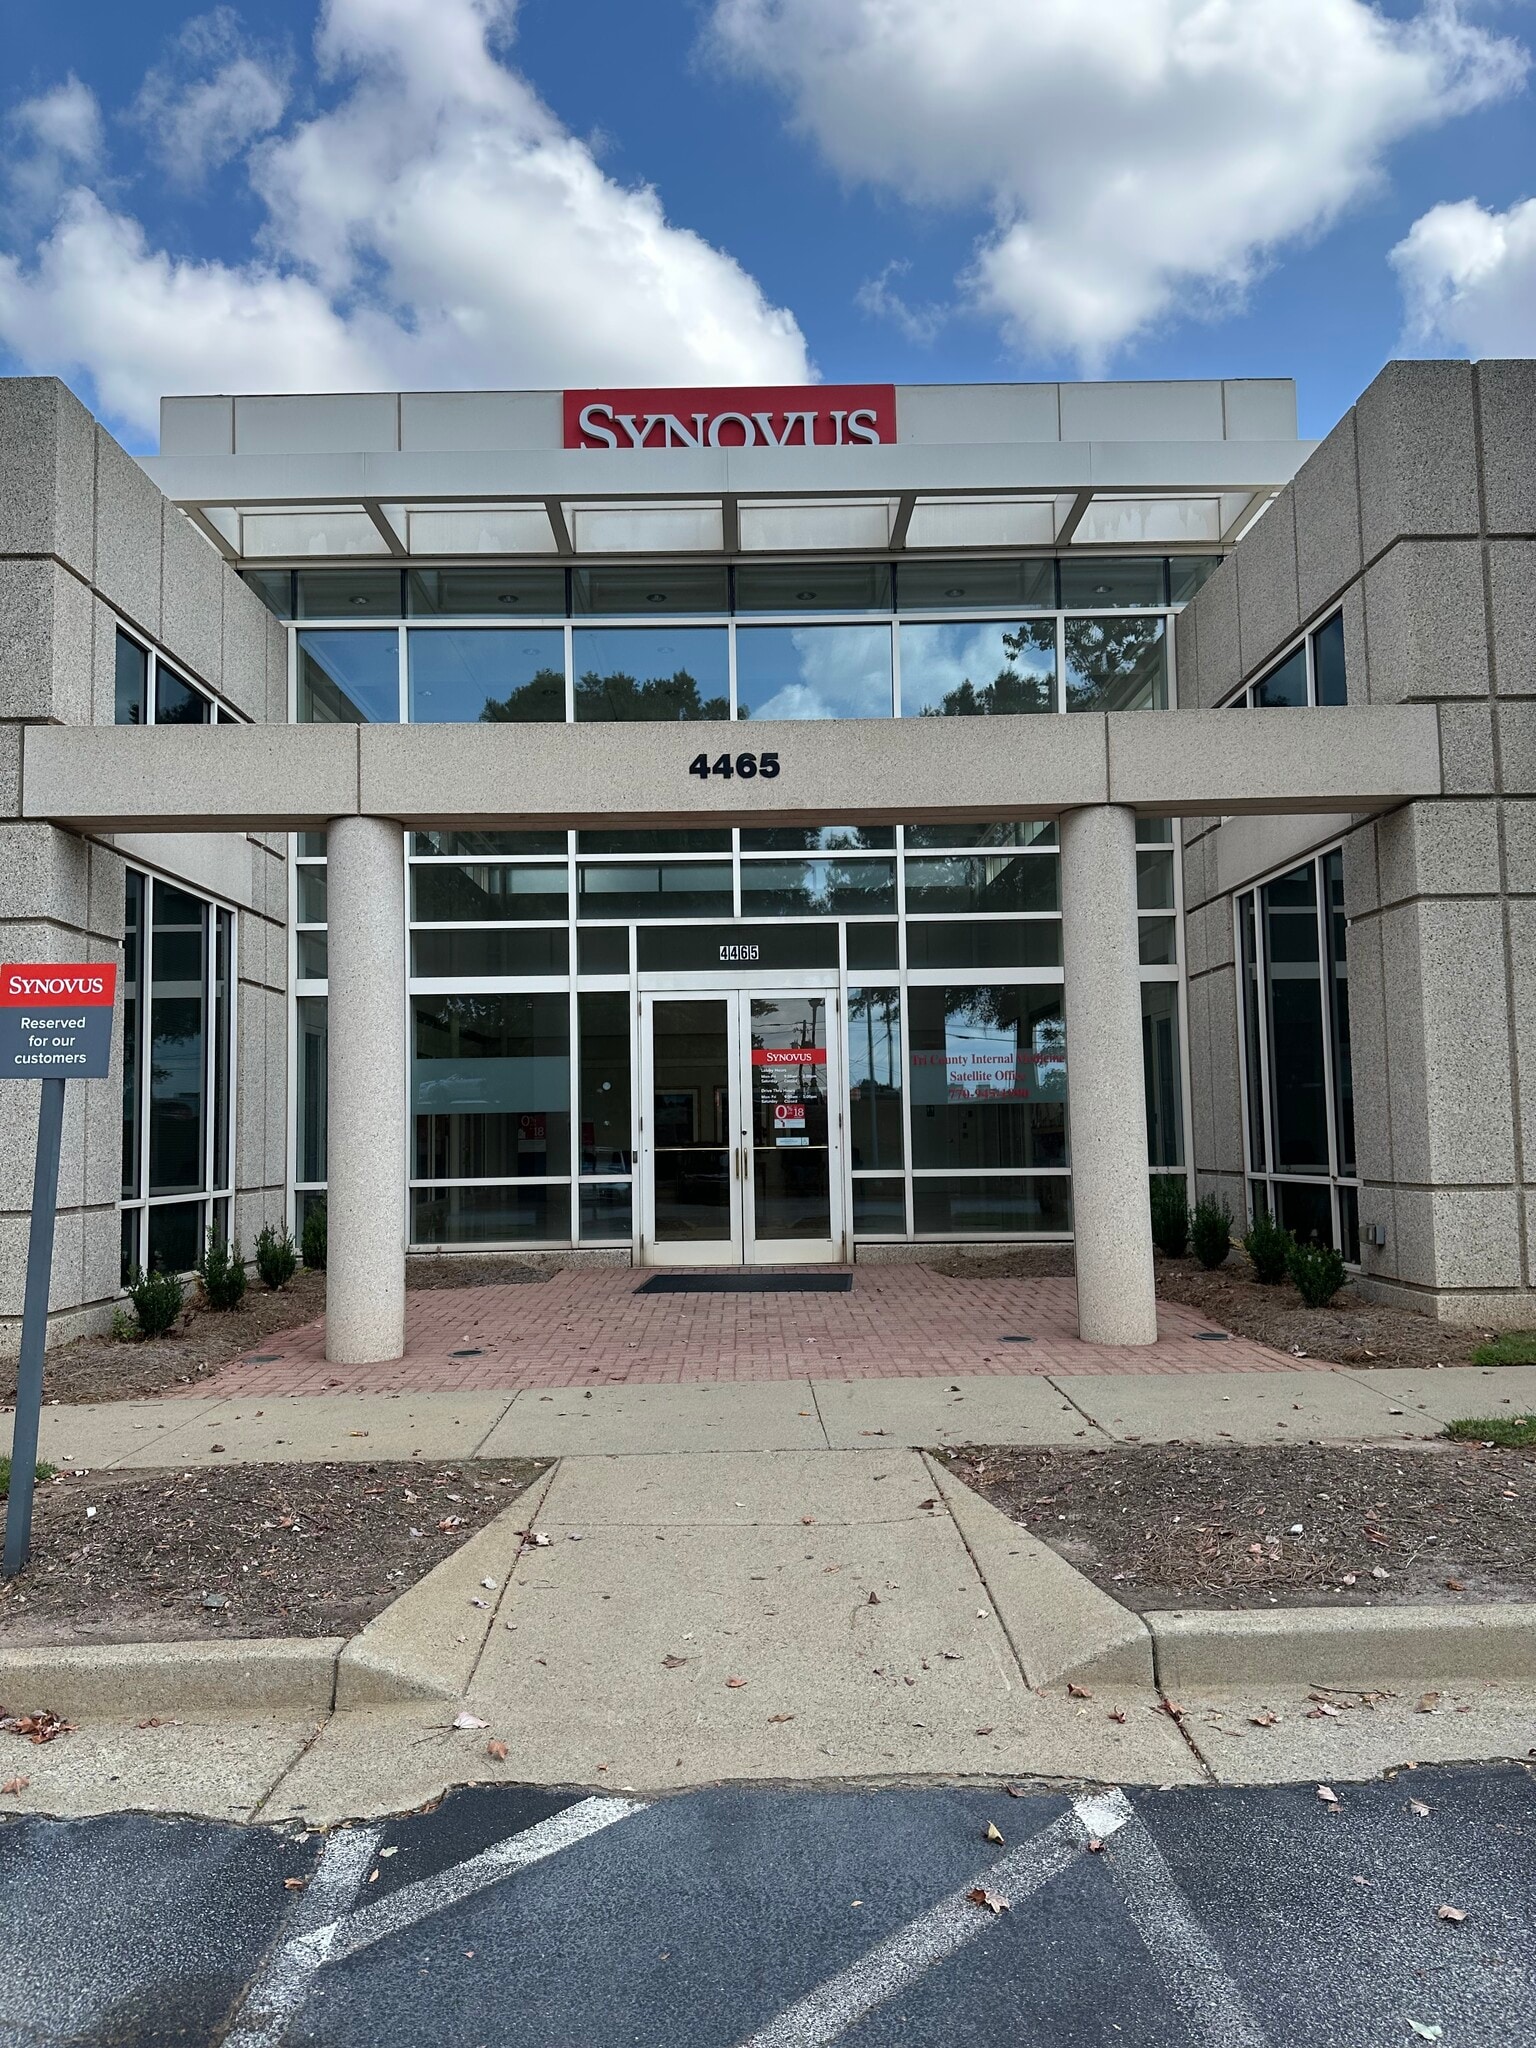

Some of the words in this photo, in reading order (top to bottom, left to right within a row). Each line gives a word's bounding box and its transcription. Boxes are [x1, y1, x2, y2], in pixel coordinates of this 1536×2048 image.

[579, 404, 880, 449] SYNOVUS
[689, 752, 781, 779] 4465
[720, 945, 759, 960] 4465
[9, 976, 103, 994] SYNOVUS
[21, 1017, 86, 1029] Reserved
[29, 1035, 48, 1047] for
[52, 1037, 76, 1047] our
[14, 1053, 87, 1064] customers
[766, 1052, 812, 1062] SYNOVUS
[912, 1055, 927, 1066] Tri
[930, 1054, 968, 1066] County
[972, 1053, 1014, 1065] Internal
[950, 1070, 992, 1081] Satellite
[794, 1108, 804, 1117] 18
